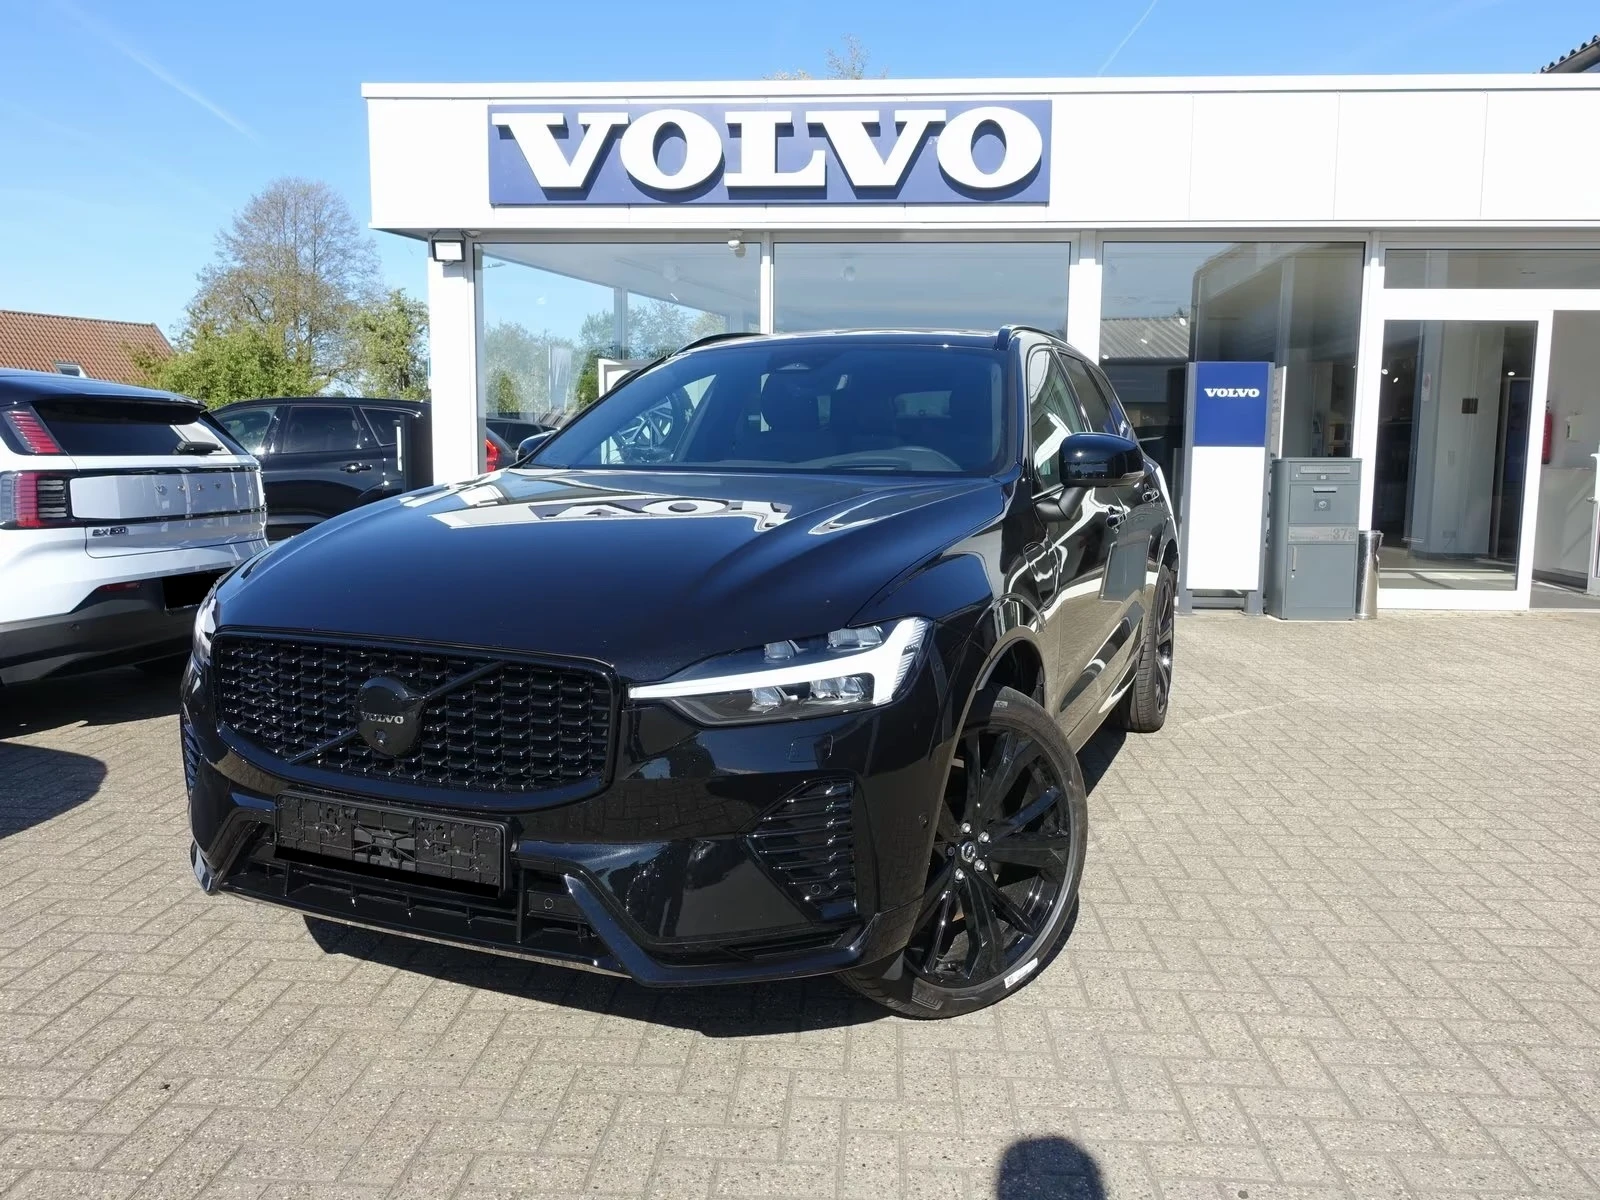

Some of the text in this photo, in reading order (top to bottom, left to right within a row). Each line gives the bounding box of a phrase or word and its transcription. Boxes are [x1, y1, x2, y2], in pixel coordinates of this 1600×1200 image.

[491, 106, 1043, 190] VOLVO
[1204, 387, 1260, 398] VOLVO
[360, 711, 405, 725] VOLVO
